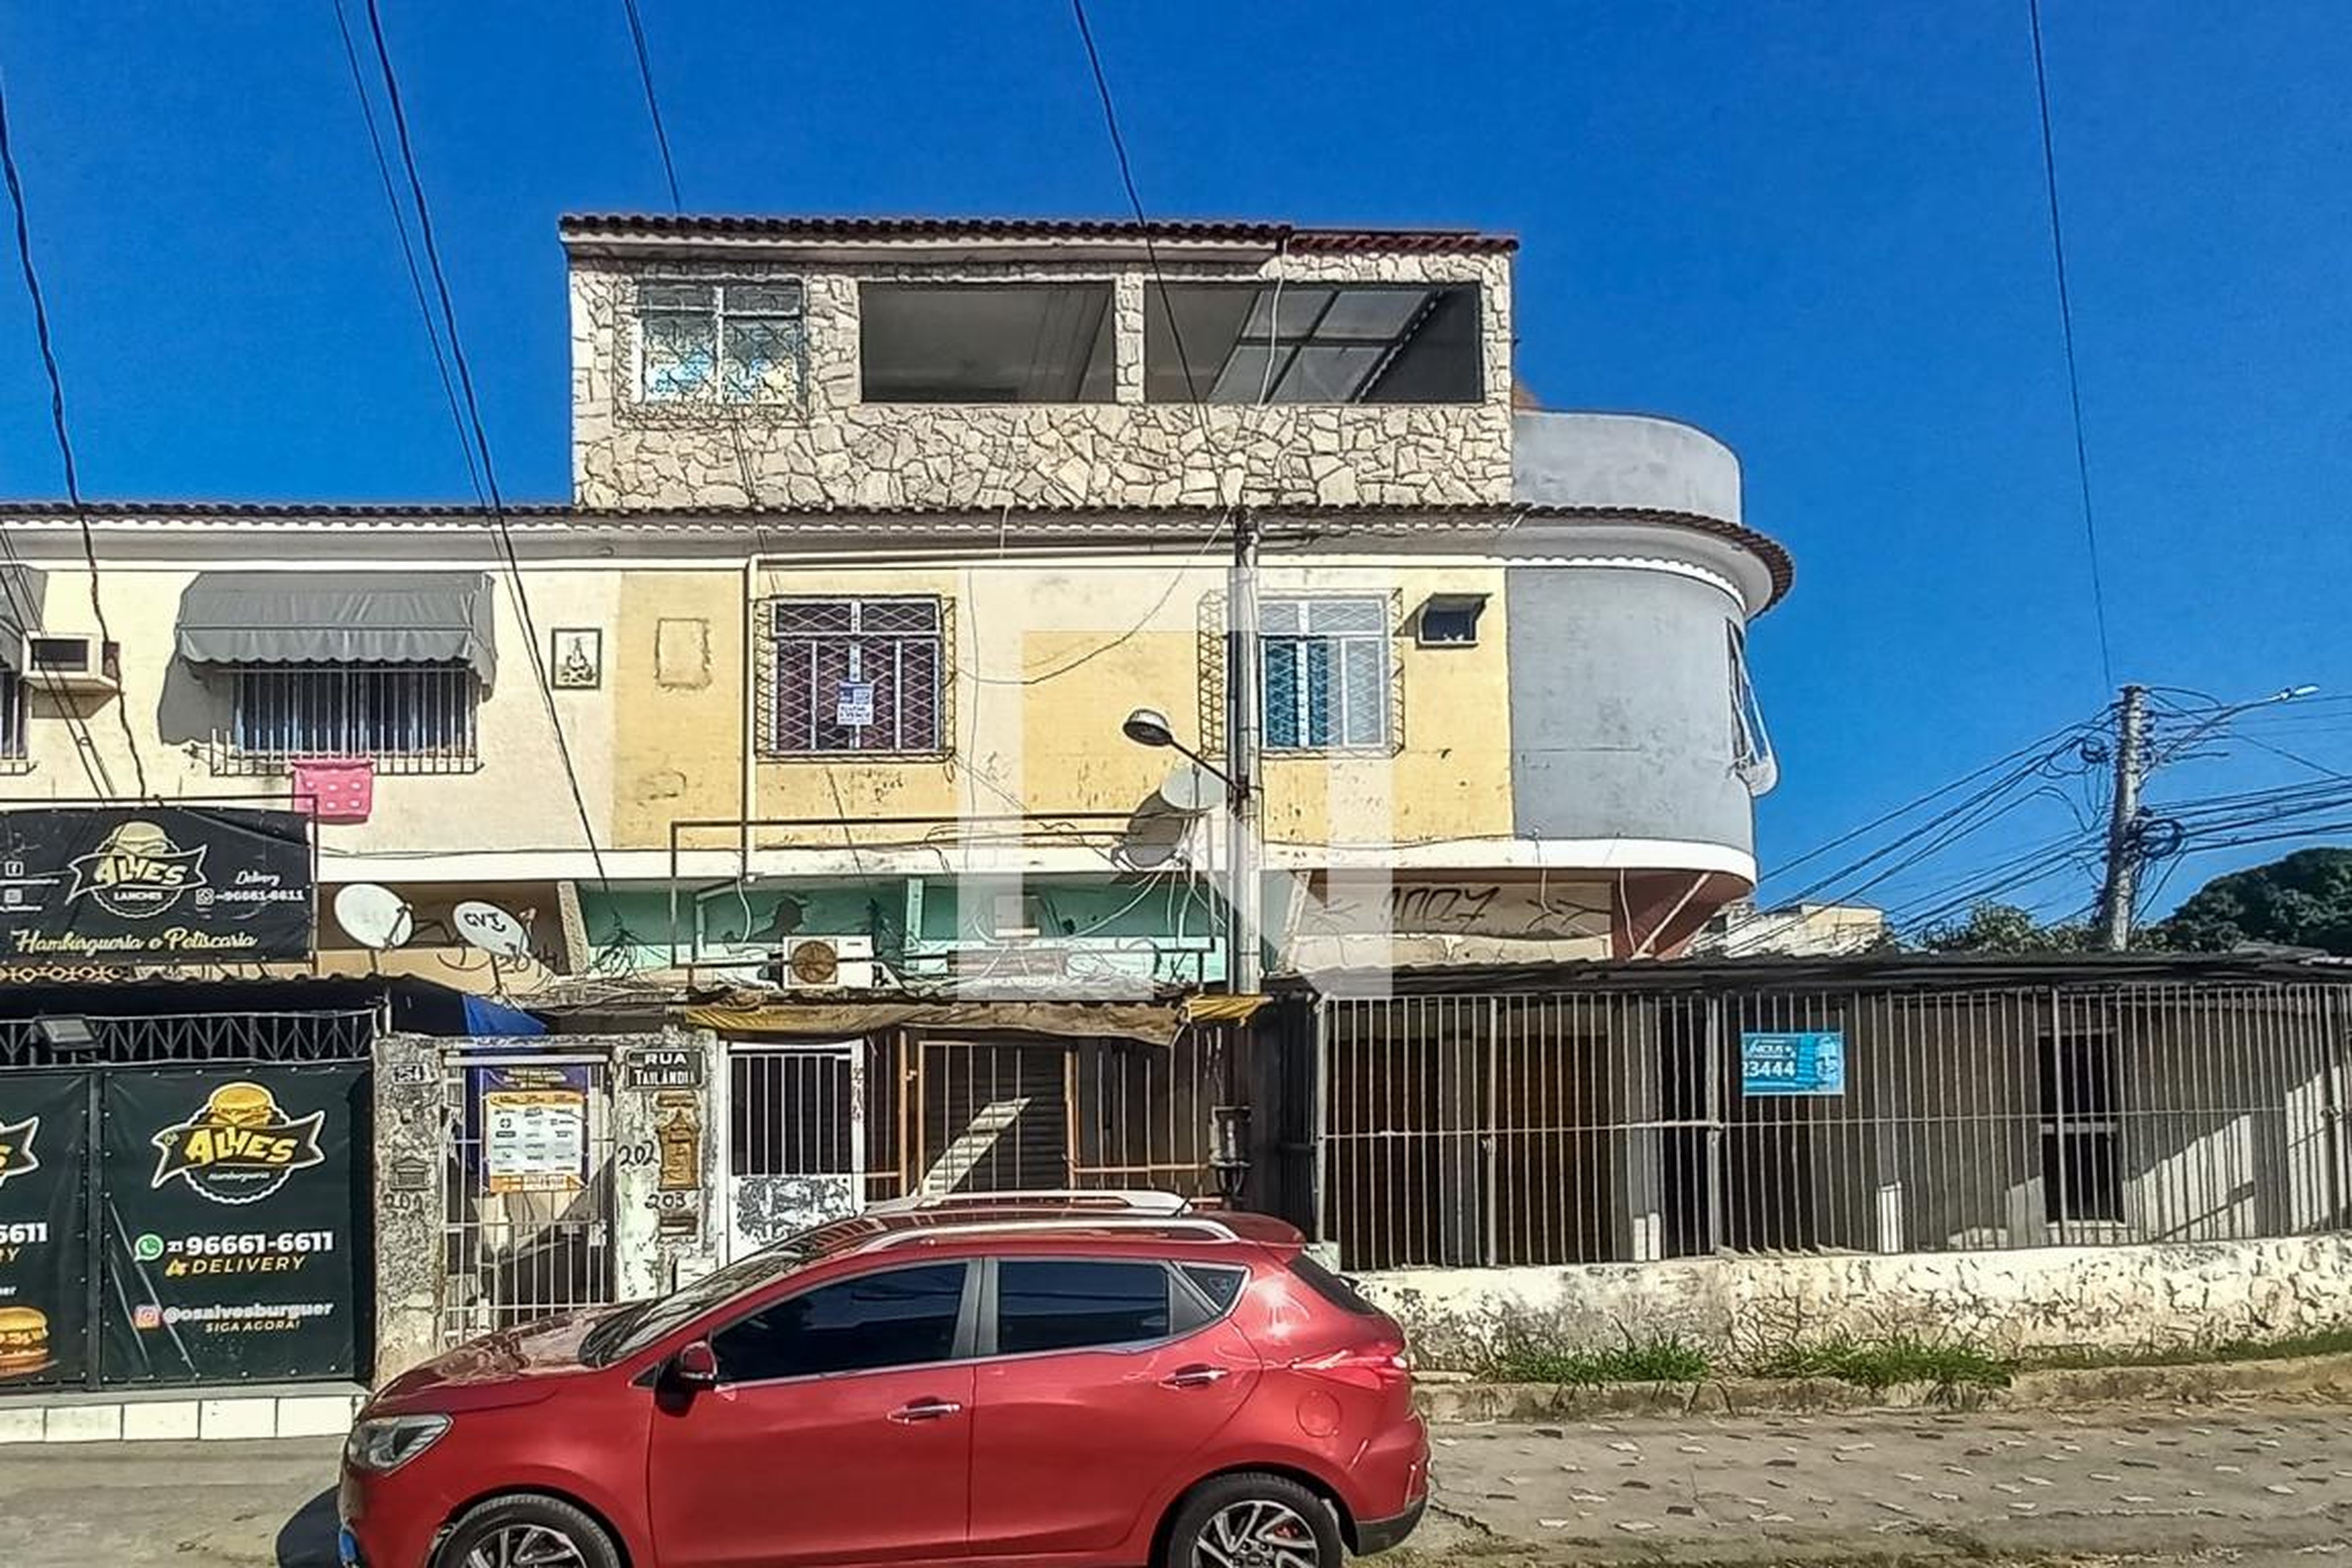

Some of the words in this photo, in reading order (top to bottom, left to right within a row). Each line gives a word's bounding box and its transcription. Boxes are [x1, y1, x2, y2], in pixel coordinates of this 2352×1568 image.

[645, 1053, 687, 1065] RUA
[618, 1140, 659, 1166] 202
[645, 1193, 685, 1209] 203
[186, 1232, 333, 1256] 96661-6611
[191, 1256, 306, 1274] DELIVERY
[205, 1322, 240, 1332] SIGA
[243, 1321, 300, 1332] AGORA!
